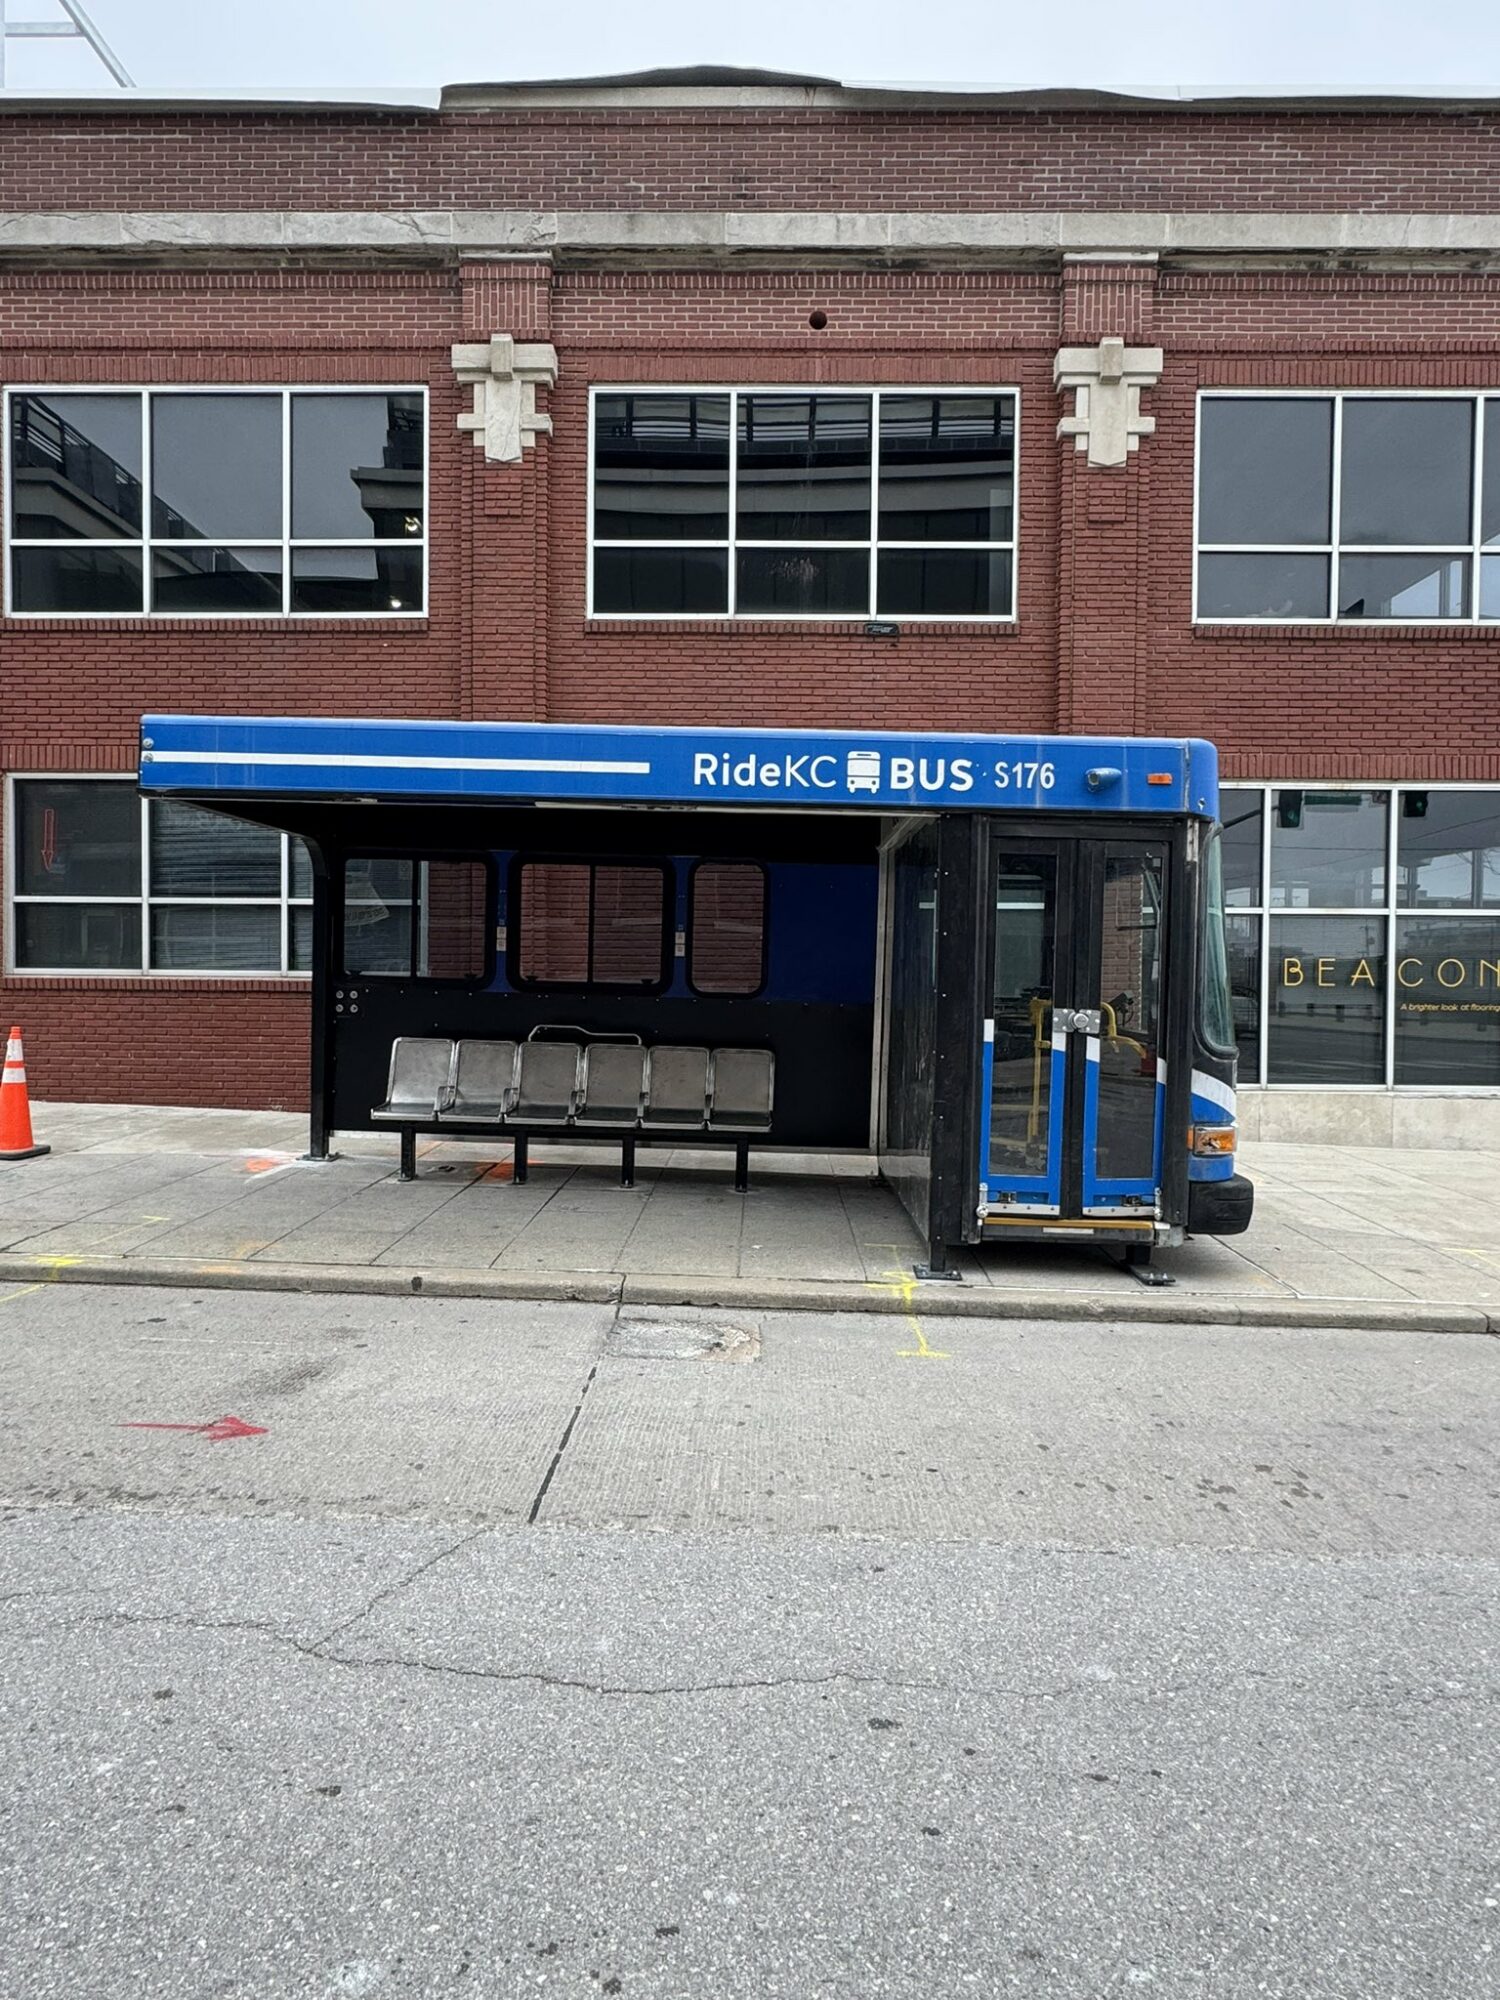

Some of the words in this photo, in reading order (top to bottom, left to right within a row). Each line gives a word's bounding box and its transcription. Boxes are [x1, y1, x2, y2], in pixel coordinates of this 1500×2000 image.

[693, 753, 837, 788] RideKC
[890, 758, 974, 791] BUS
[994, 761, 1055, 789] S176
[1283, 958, 1500, 988] BEACON
[1408, 1003, 1440, 1012] brighter
[1440, 1003, 1458, 1011] look
